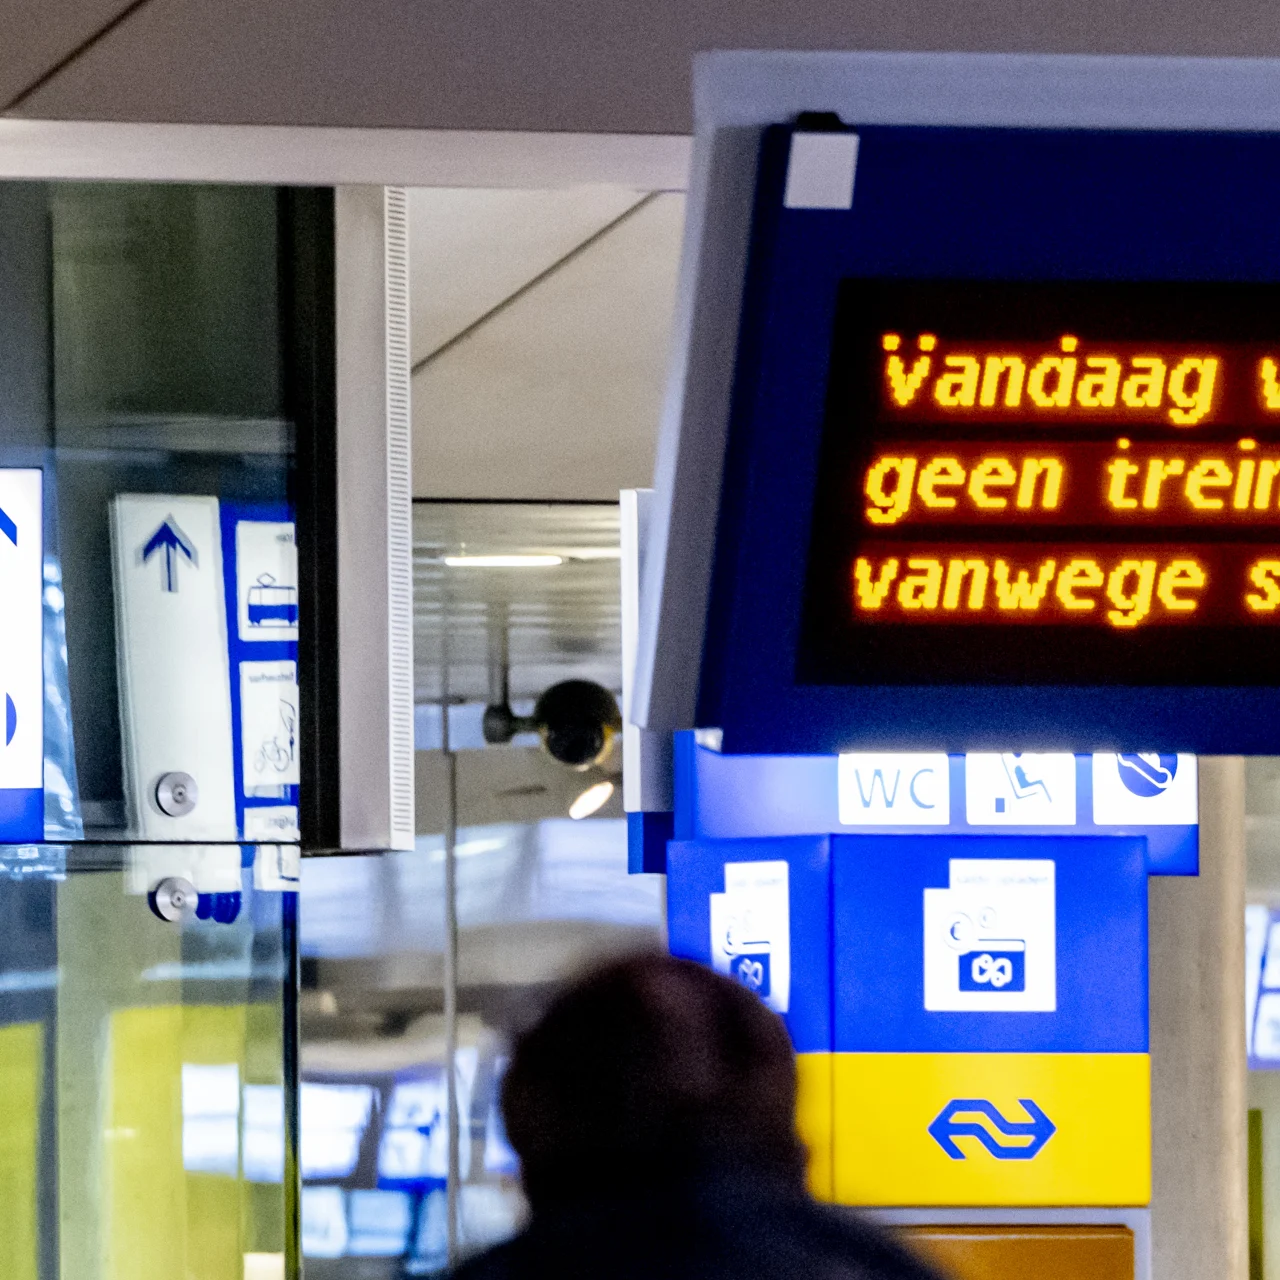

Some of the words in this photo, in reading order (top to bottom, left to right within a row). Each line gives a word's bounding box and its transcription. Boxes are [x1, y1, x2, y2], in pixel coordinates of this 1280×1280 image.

[883, 334, 1219, 426] Vandaag
[865, 455, 1065, 524] geen
[854, 555, 1208, 628] vanwege
[854, 767, 936, 810] WC
